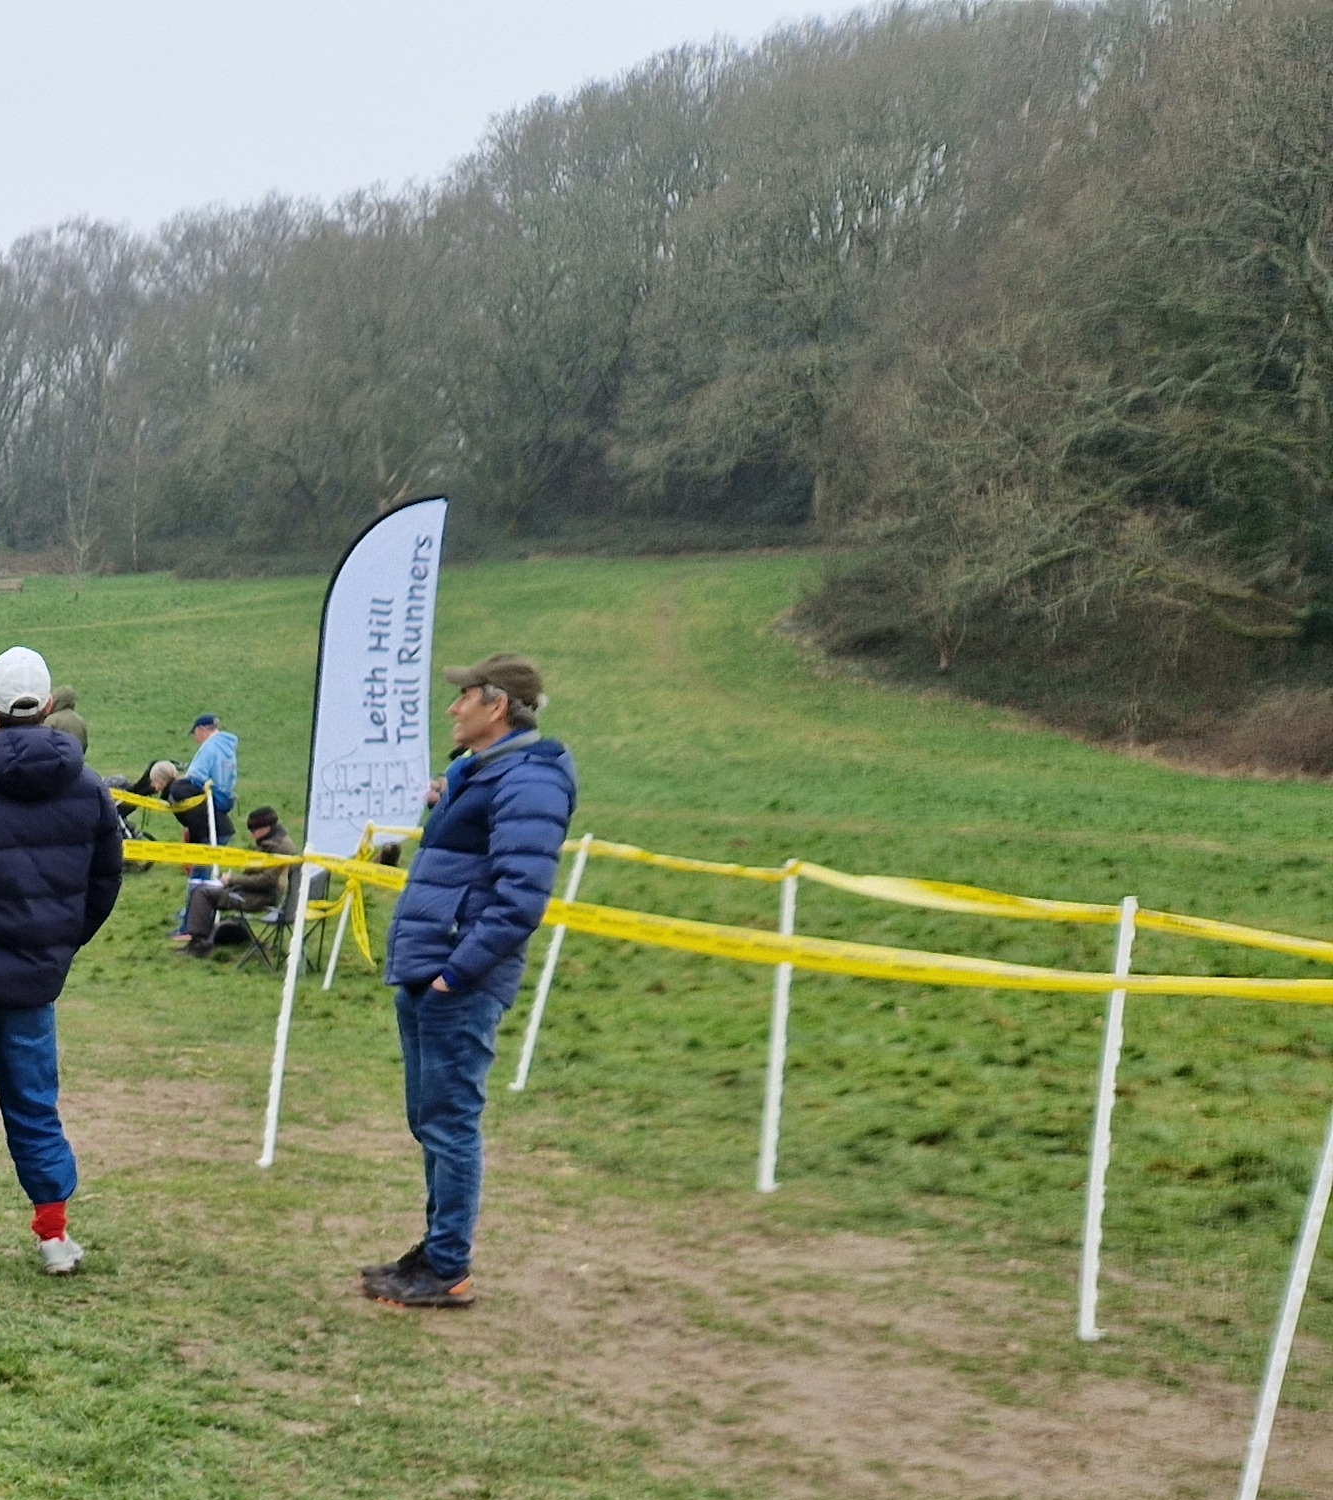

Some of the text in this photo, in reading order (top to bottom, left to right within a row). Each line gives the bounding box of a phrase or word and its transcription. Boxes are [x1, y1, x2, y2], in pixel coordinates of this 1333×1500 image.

[363, 597, 394, 743] Leith Hill
[393, 534, 433, 744] Trail Runners
